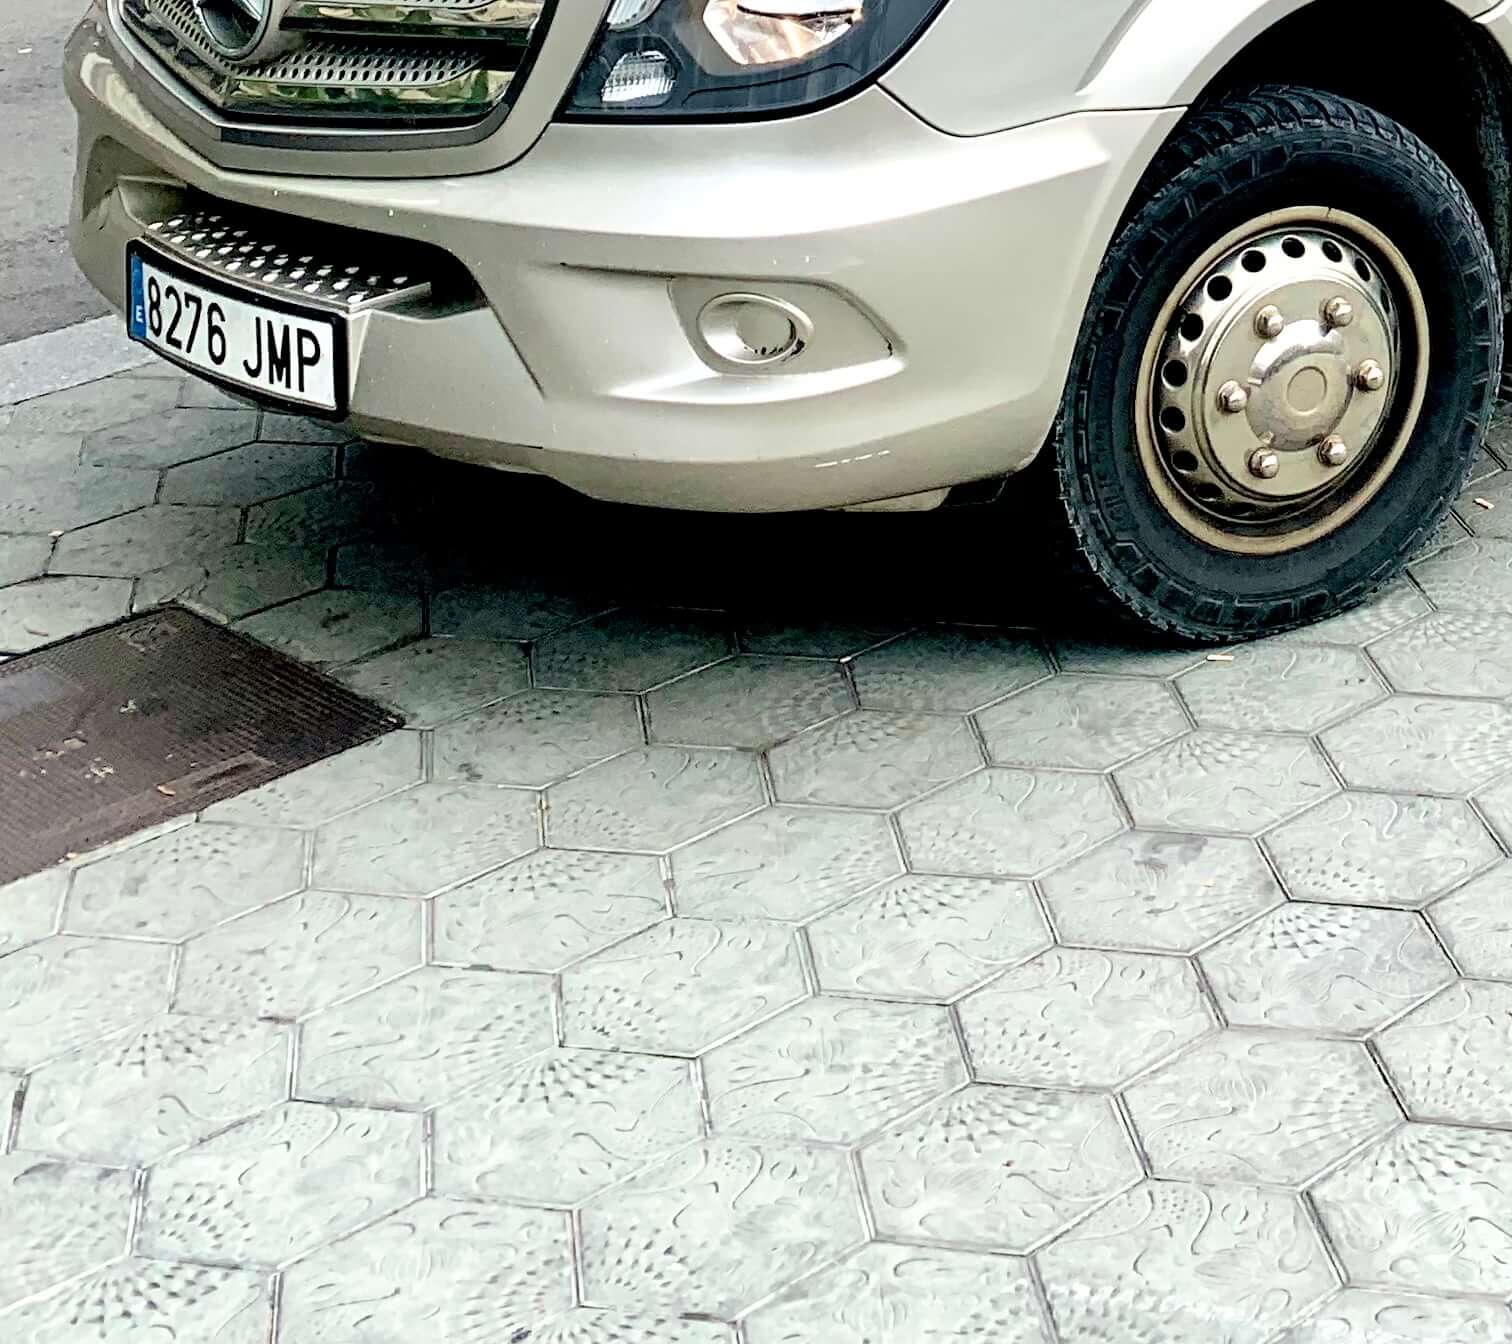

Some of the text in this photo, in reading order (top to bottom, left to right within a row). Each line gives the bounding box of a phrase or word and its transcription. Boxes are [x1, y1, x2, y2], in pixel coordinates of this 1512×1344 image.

[135, 276, 321, 393] E 8276 JMP
